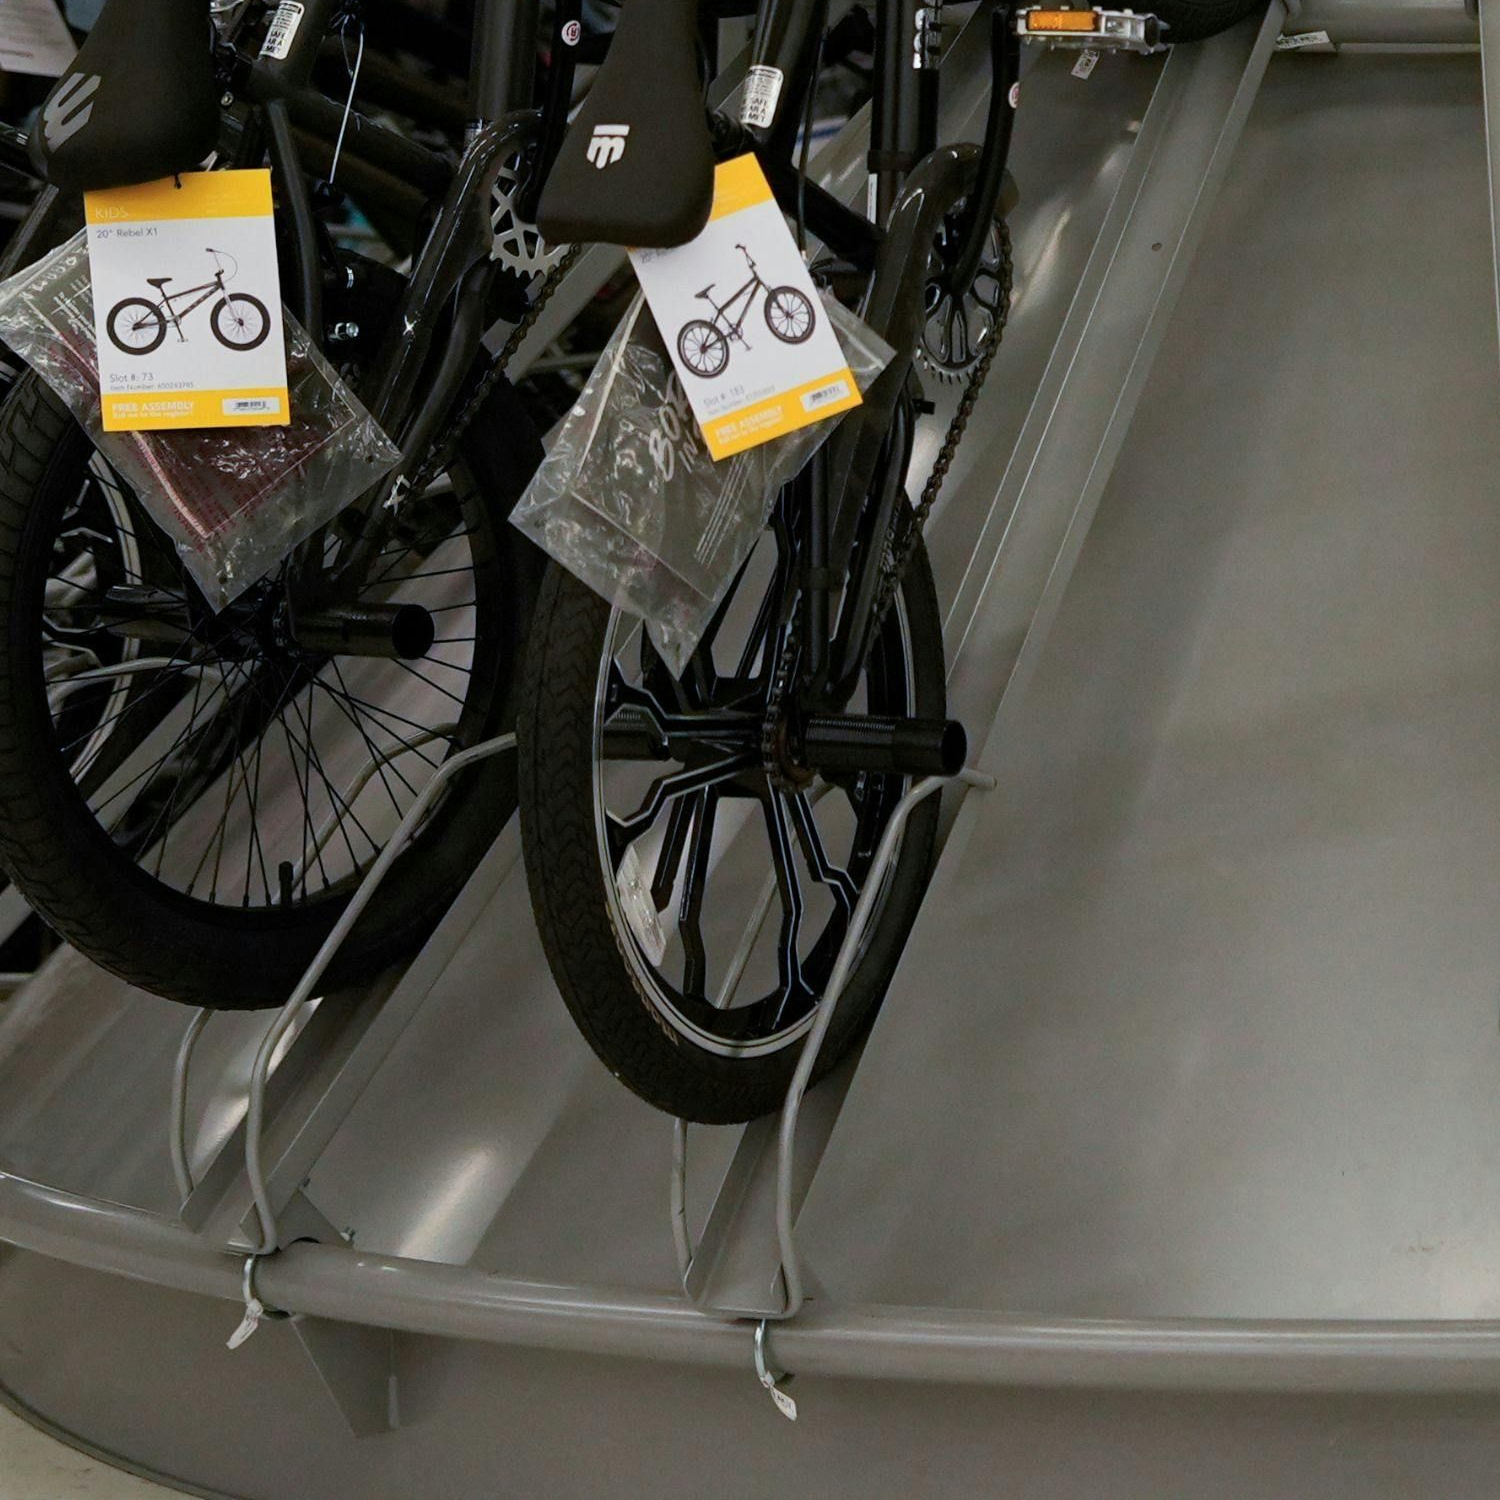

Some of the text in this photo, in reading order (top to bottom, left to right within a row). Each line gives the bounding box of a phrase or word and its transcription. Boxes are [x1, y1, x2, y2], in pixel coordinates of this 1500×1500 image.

[95, 206, 129, 220] KIDS
[117, 227, 144, 238] Rebel
[146, 227, 158, 237] X1
[109, 373, 128, 383] Slot
[142, 372, 154, 382] 73
